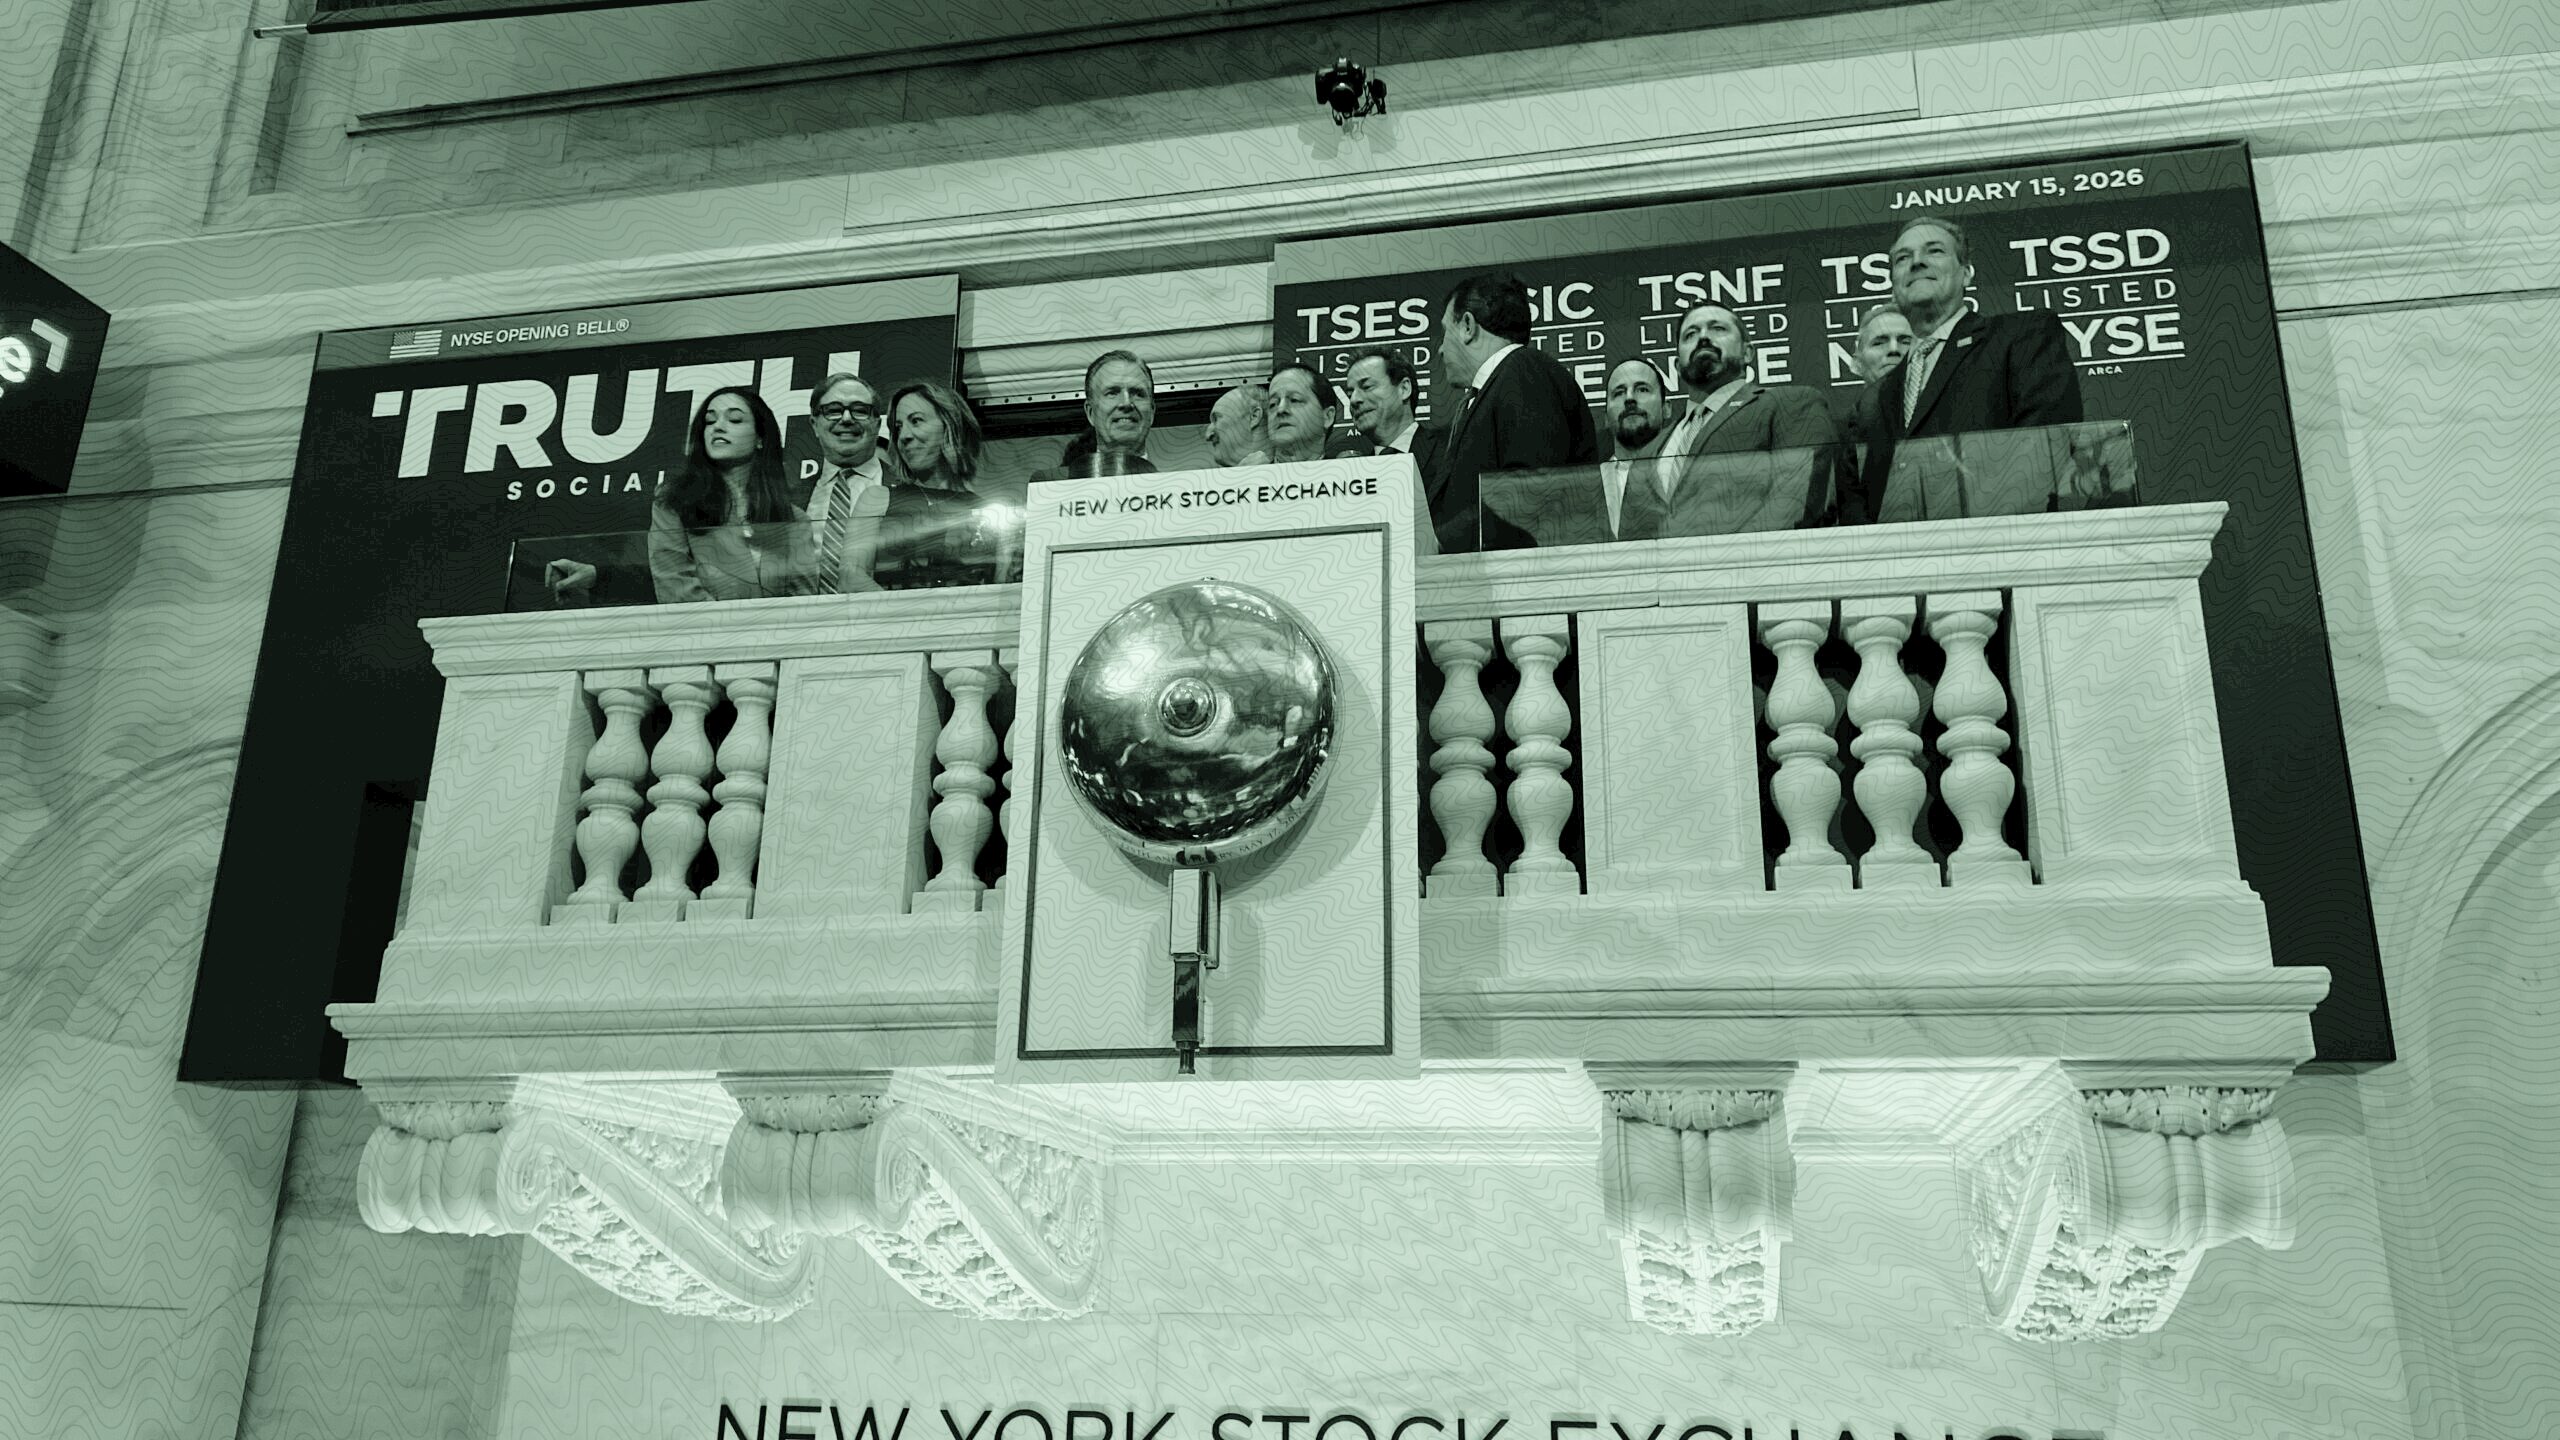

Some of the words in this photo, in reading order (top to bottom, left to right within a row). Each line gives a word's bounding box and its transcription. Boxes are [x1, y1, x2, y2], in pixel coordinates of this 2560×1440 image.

[1890, 180, 2021, 210] JANUARY
[2029, 177, 2066, 197] 15,
[2073, 168, 2144, 192] 2026
[2009, 228, 2171, 277] TSSD
[1638, 263, 1785, 312] TSNF
[2015, 278, 2177, 312] LISTED
[450, 330, 494, 348] NYSE
[495, 323, 570, 344] OPENING
[1296, 298, 1430, 344] TSES
[1640, 313, 1788, 345] LIED
[2061, 312, 2185, 358] YSE
[1530, 331, 1605, 353] TED
[2087, 365, 2123, 376] ARCA
[1058, 498, 1108, 518] NEW
[1115, 492, 1174, 514] YORK
[1180, 486, 1252, 508] STOCK
[1257, 478, 1378, 503] EXCHANGE
